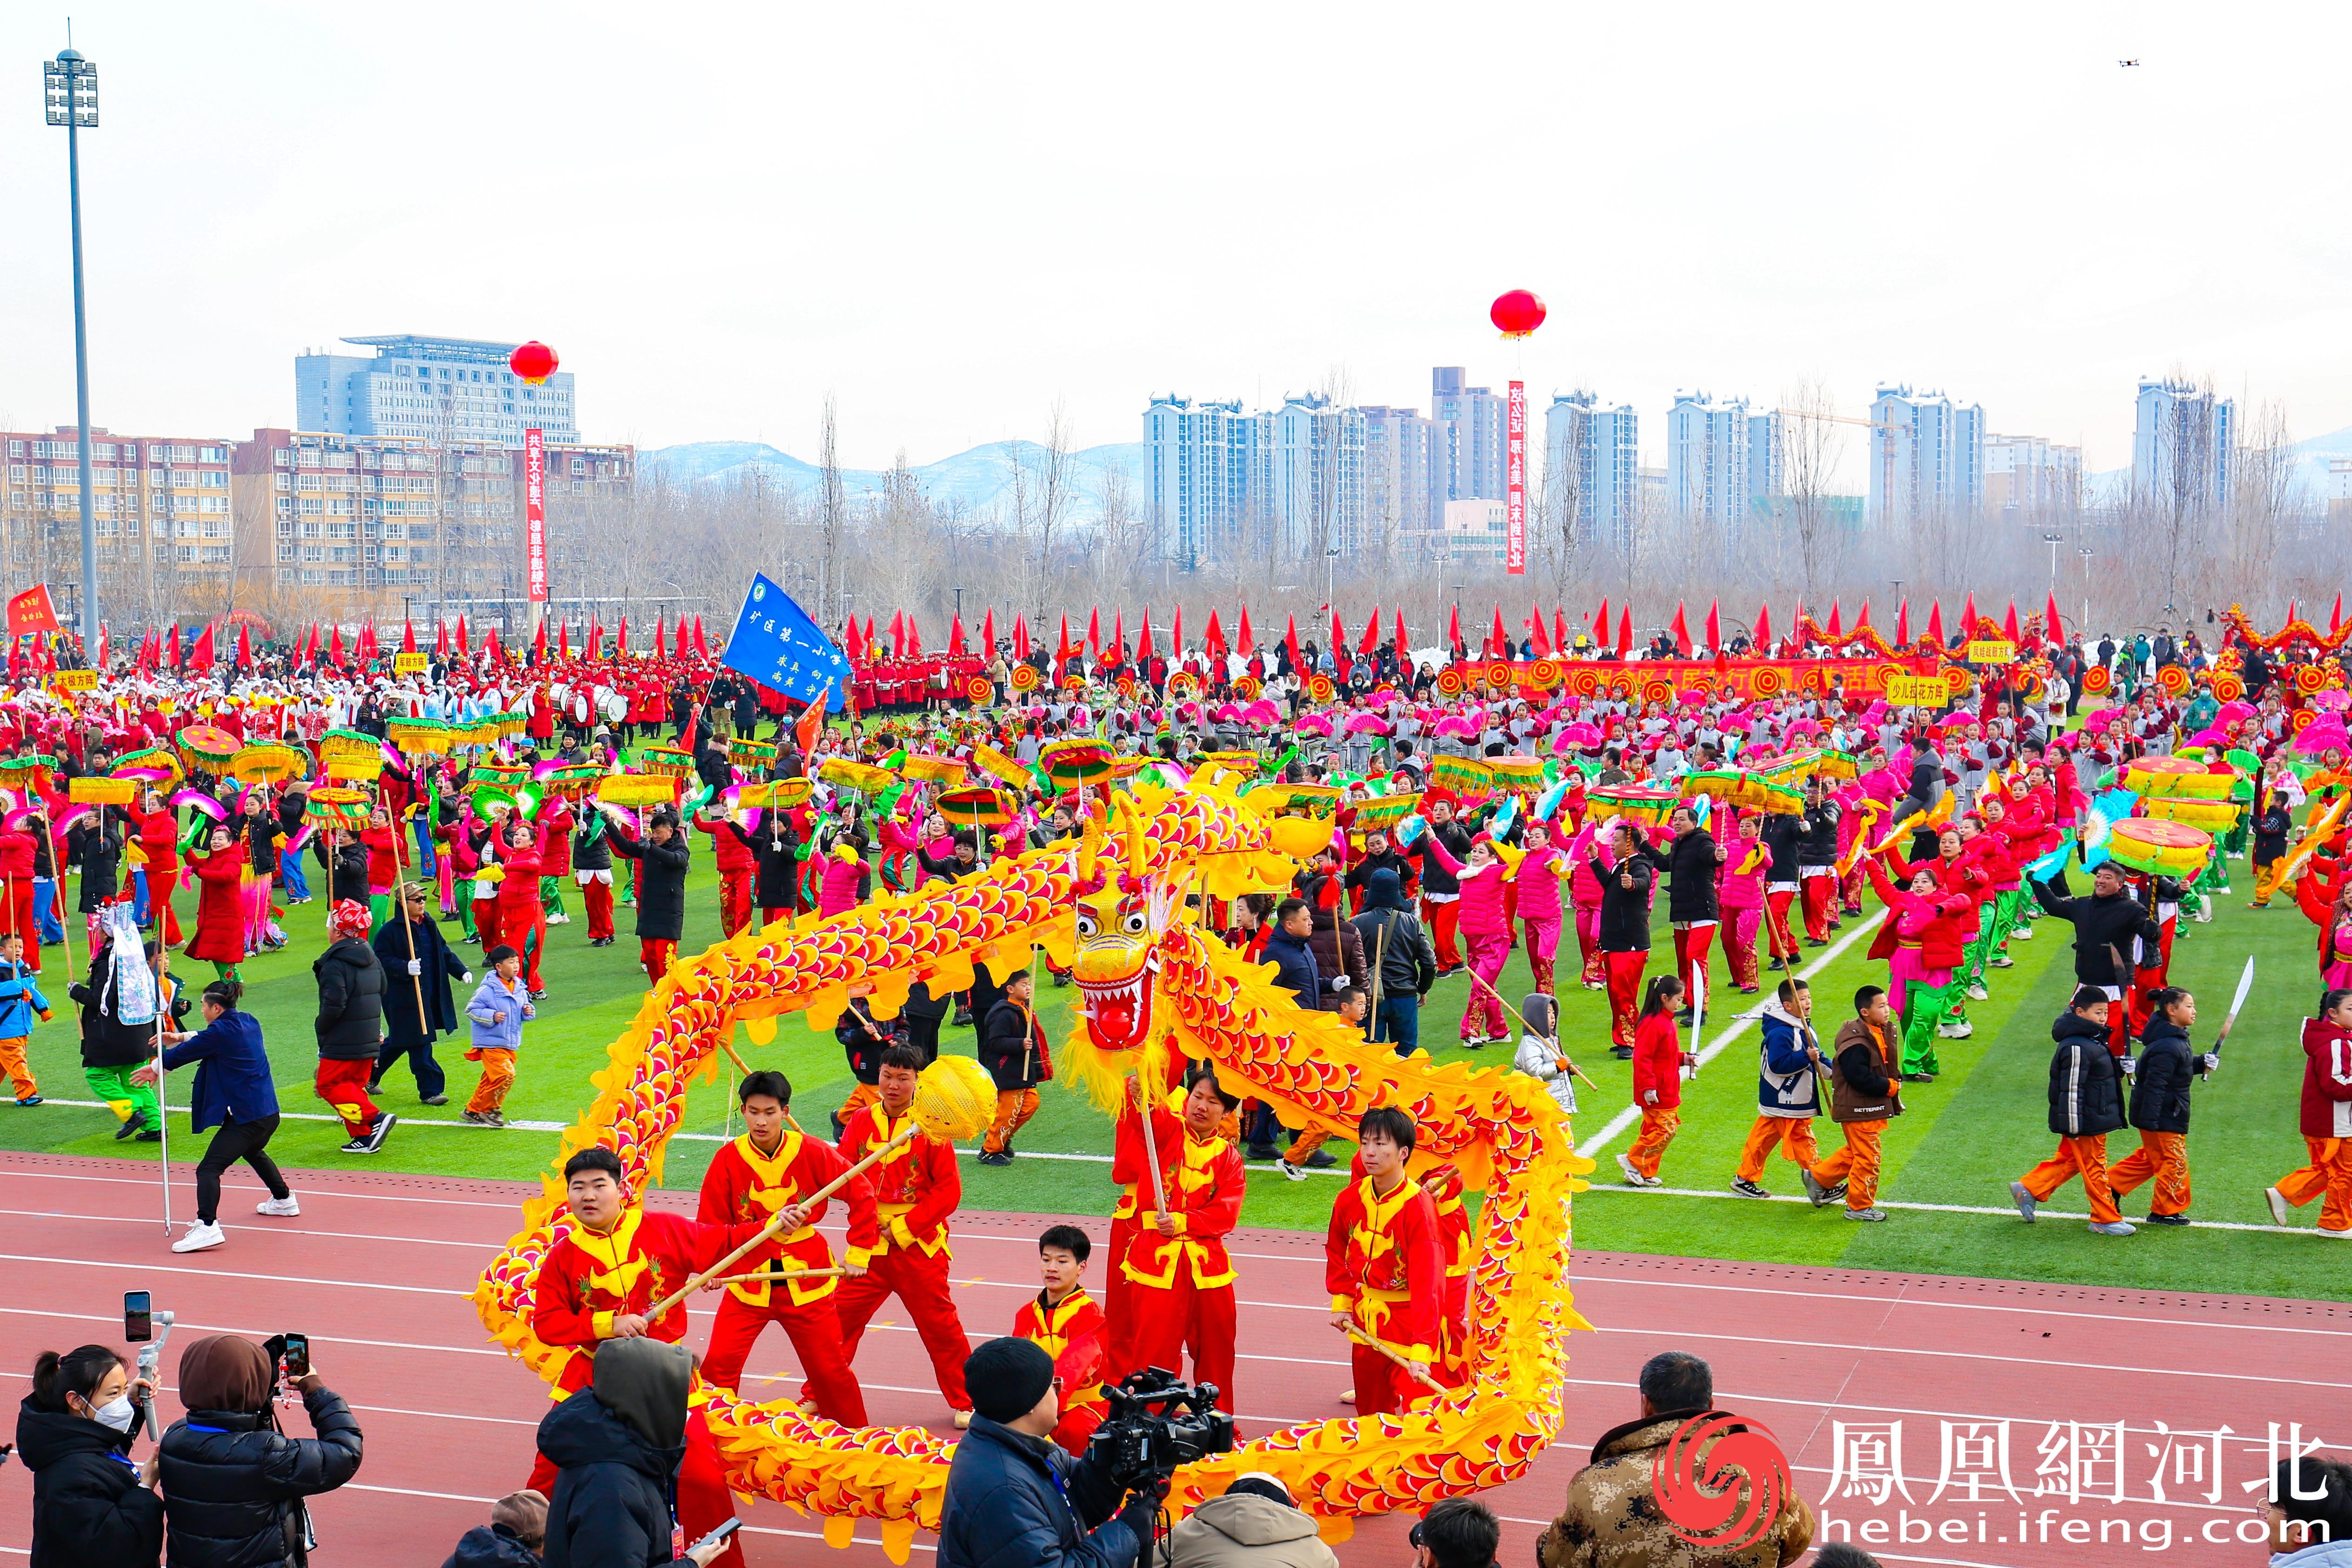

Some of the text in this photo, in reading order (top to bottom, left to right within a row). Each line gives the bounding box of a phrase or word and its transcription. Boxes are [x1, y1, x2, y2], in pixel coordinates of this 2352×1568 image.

[749, 610, 841, 666] 矿区第一小学
[400, 657, 424, 667] 军鼓方阵
[776, 654, 800, 674] 求真
[59, 674, 94, 687] 太极方阵
[772, 671, 795, 688] 尚美
[1892, 682, 1944, 701] 少儿拉花方阵
